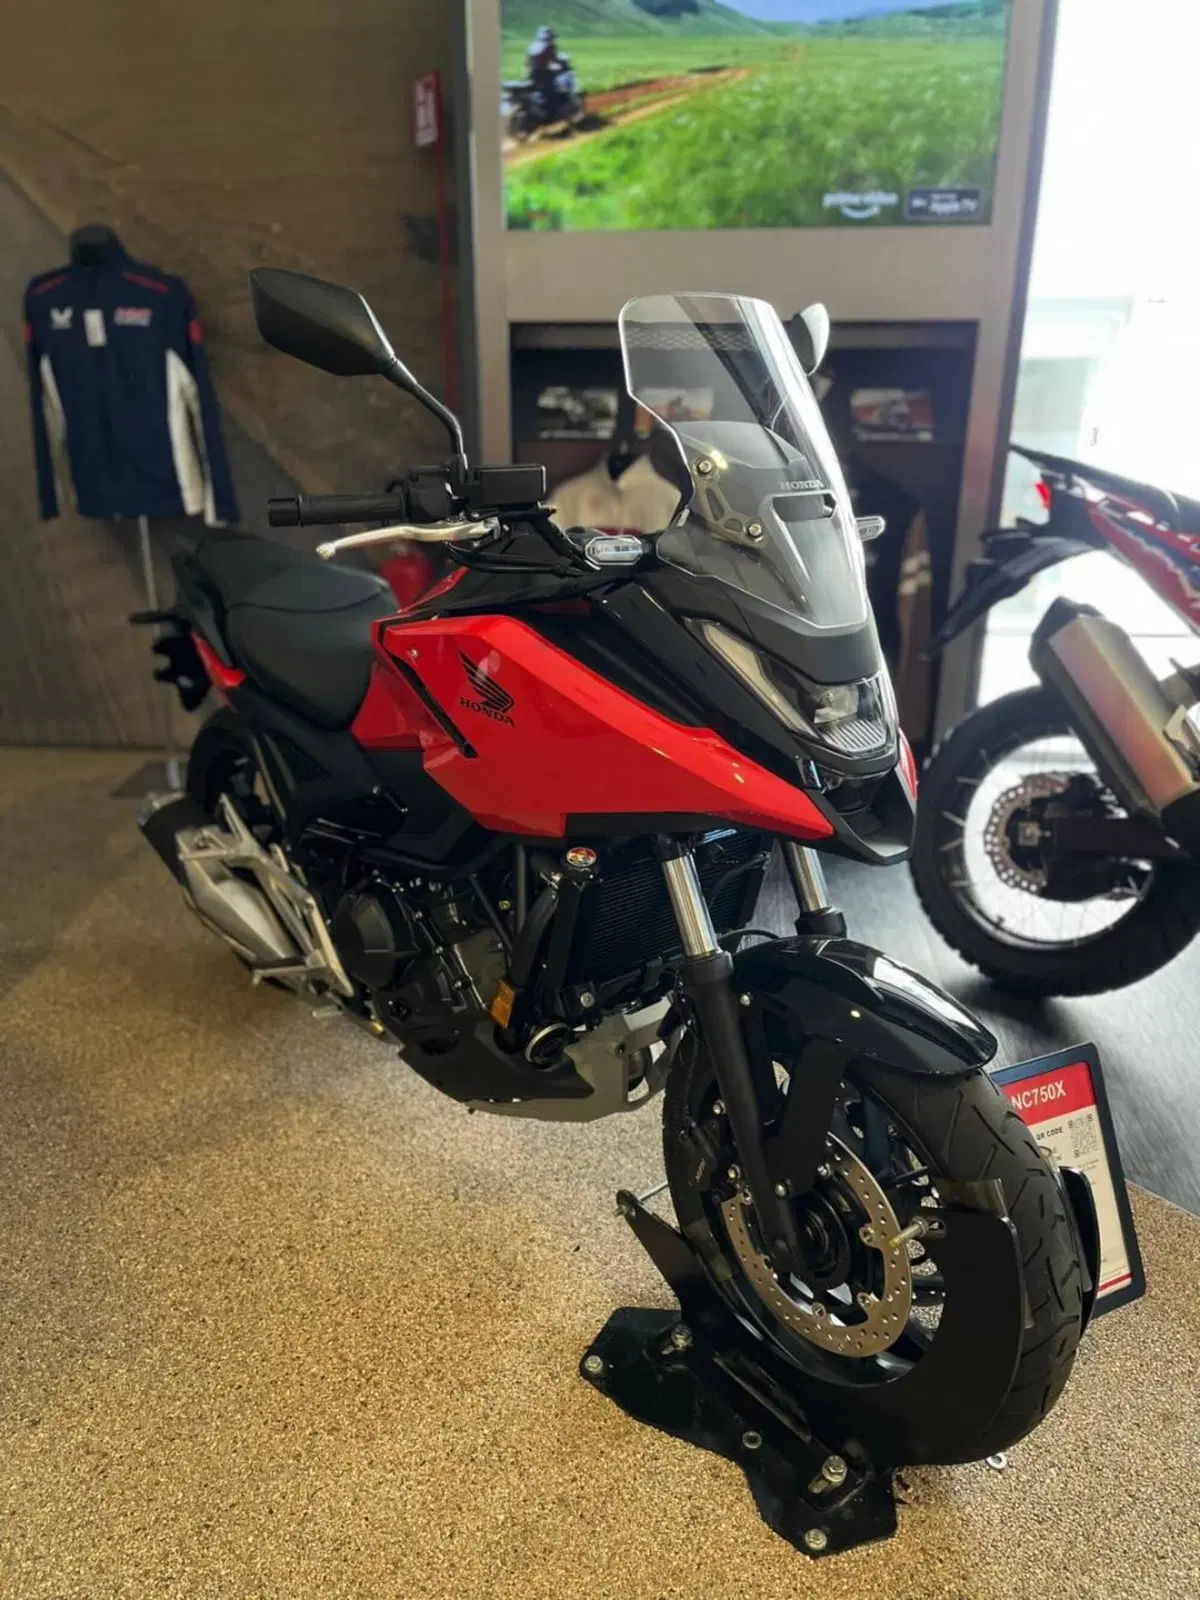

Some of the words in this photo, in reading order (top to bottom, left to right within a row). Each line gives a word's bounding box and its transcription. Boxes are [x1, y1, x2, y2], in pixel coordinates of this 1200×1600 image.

[779, 479, 824, 491] HONDA
[459, 696, 516, 728] HONDA
[1010, 1079, 1066, 1110] NC750X
[1046, 1126, 1064, 1138] CODE
